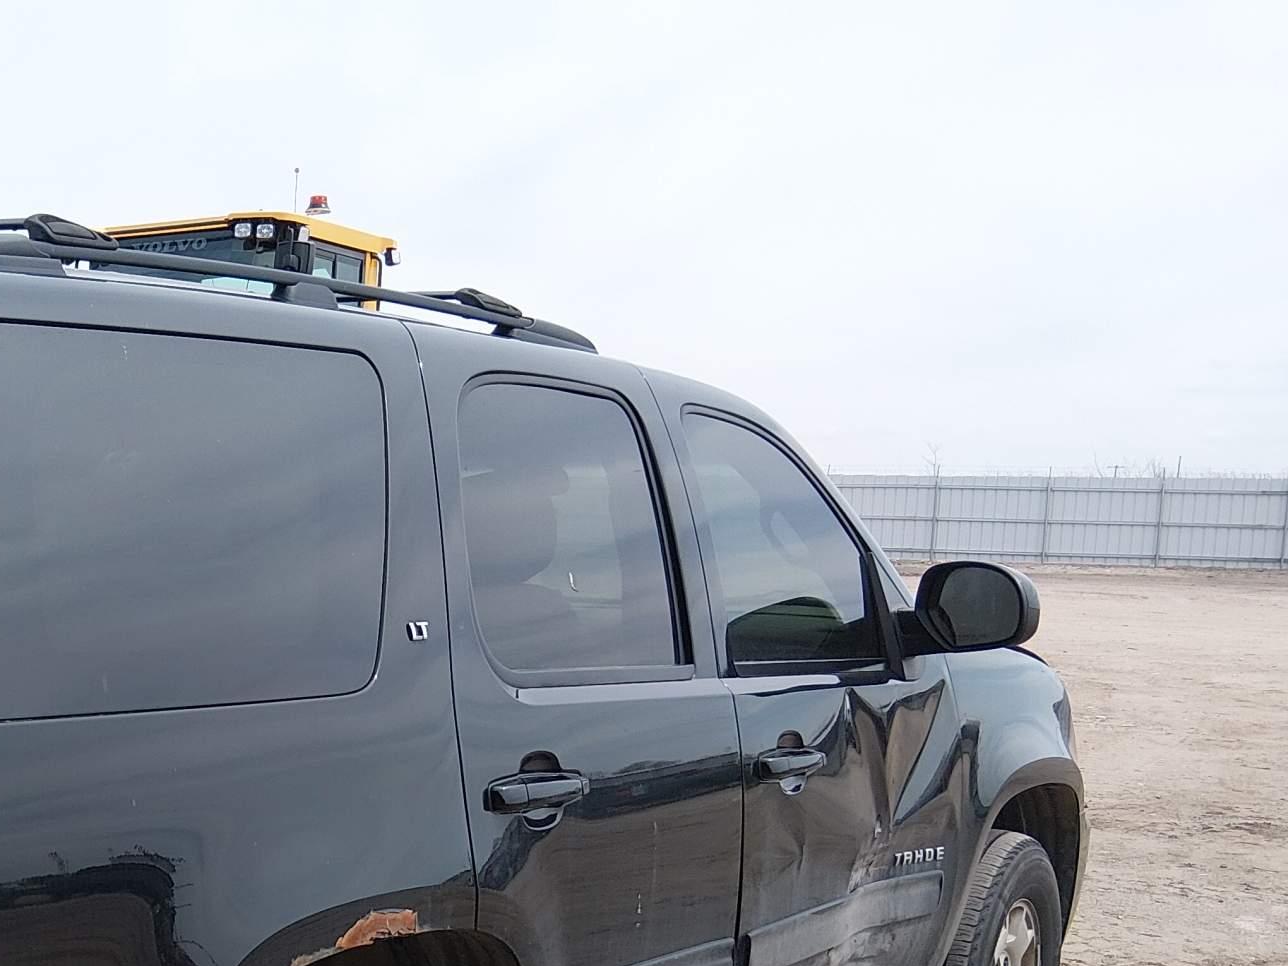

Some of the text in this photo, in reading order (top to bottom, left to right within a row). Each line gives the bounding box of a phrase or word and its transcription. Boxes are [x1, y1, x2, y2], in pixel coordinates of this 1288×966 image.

[131, 238, 208, 253] VOLVO
[408, 621, 429, 641] LT
[895, 846, 945, 866] TAHOE
